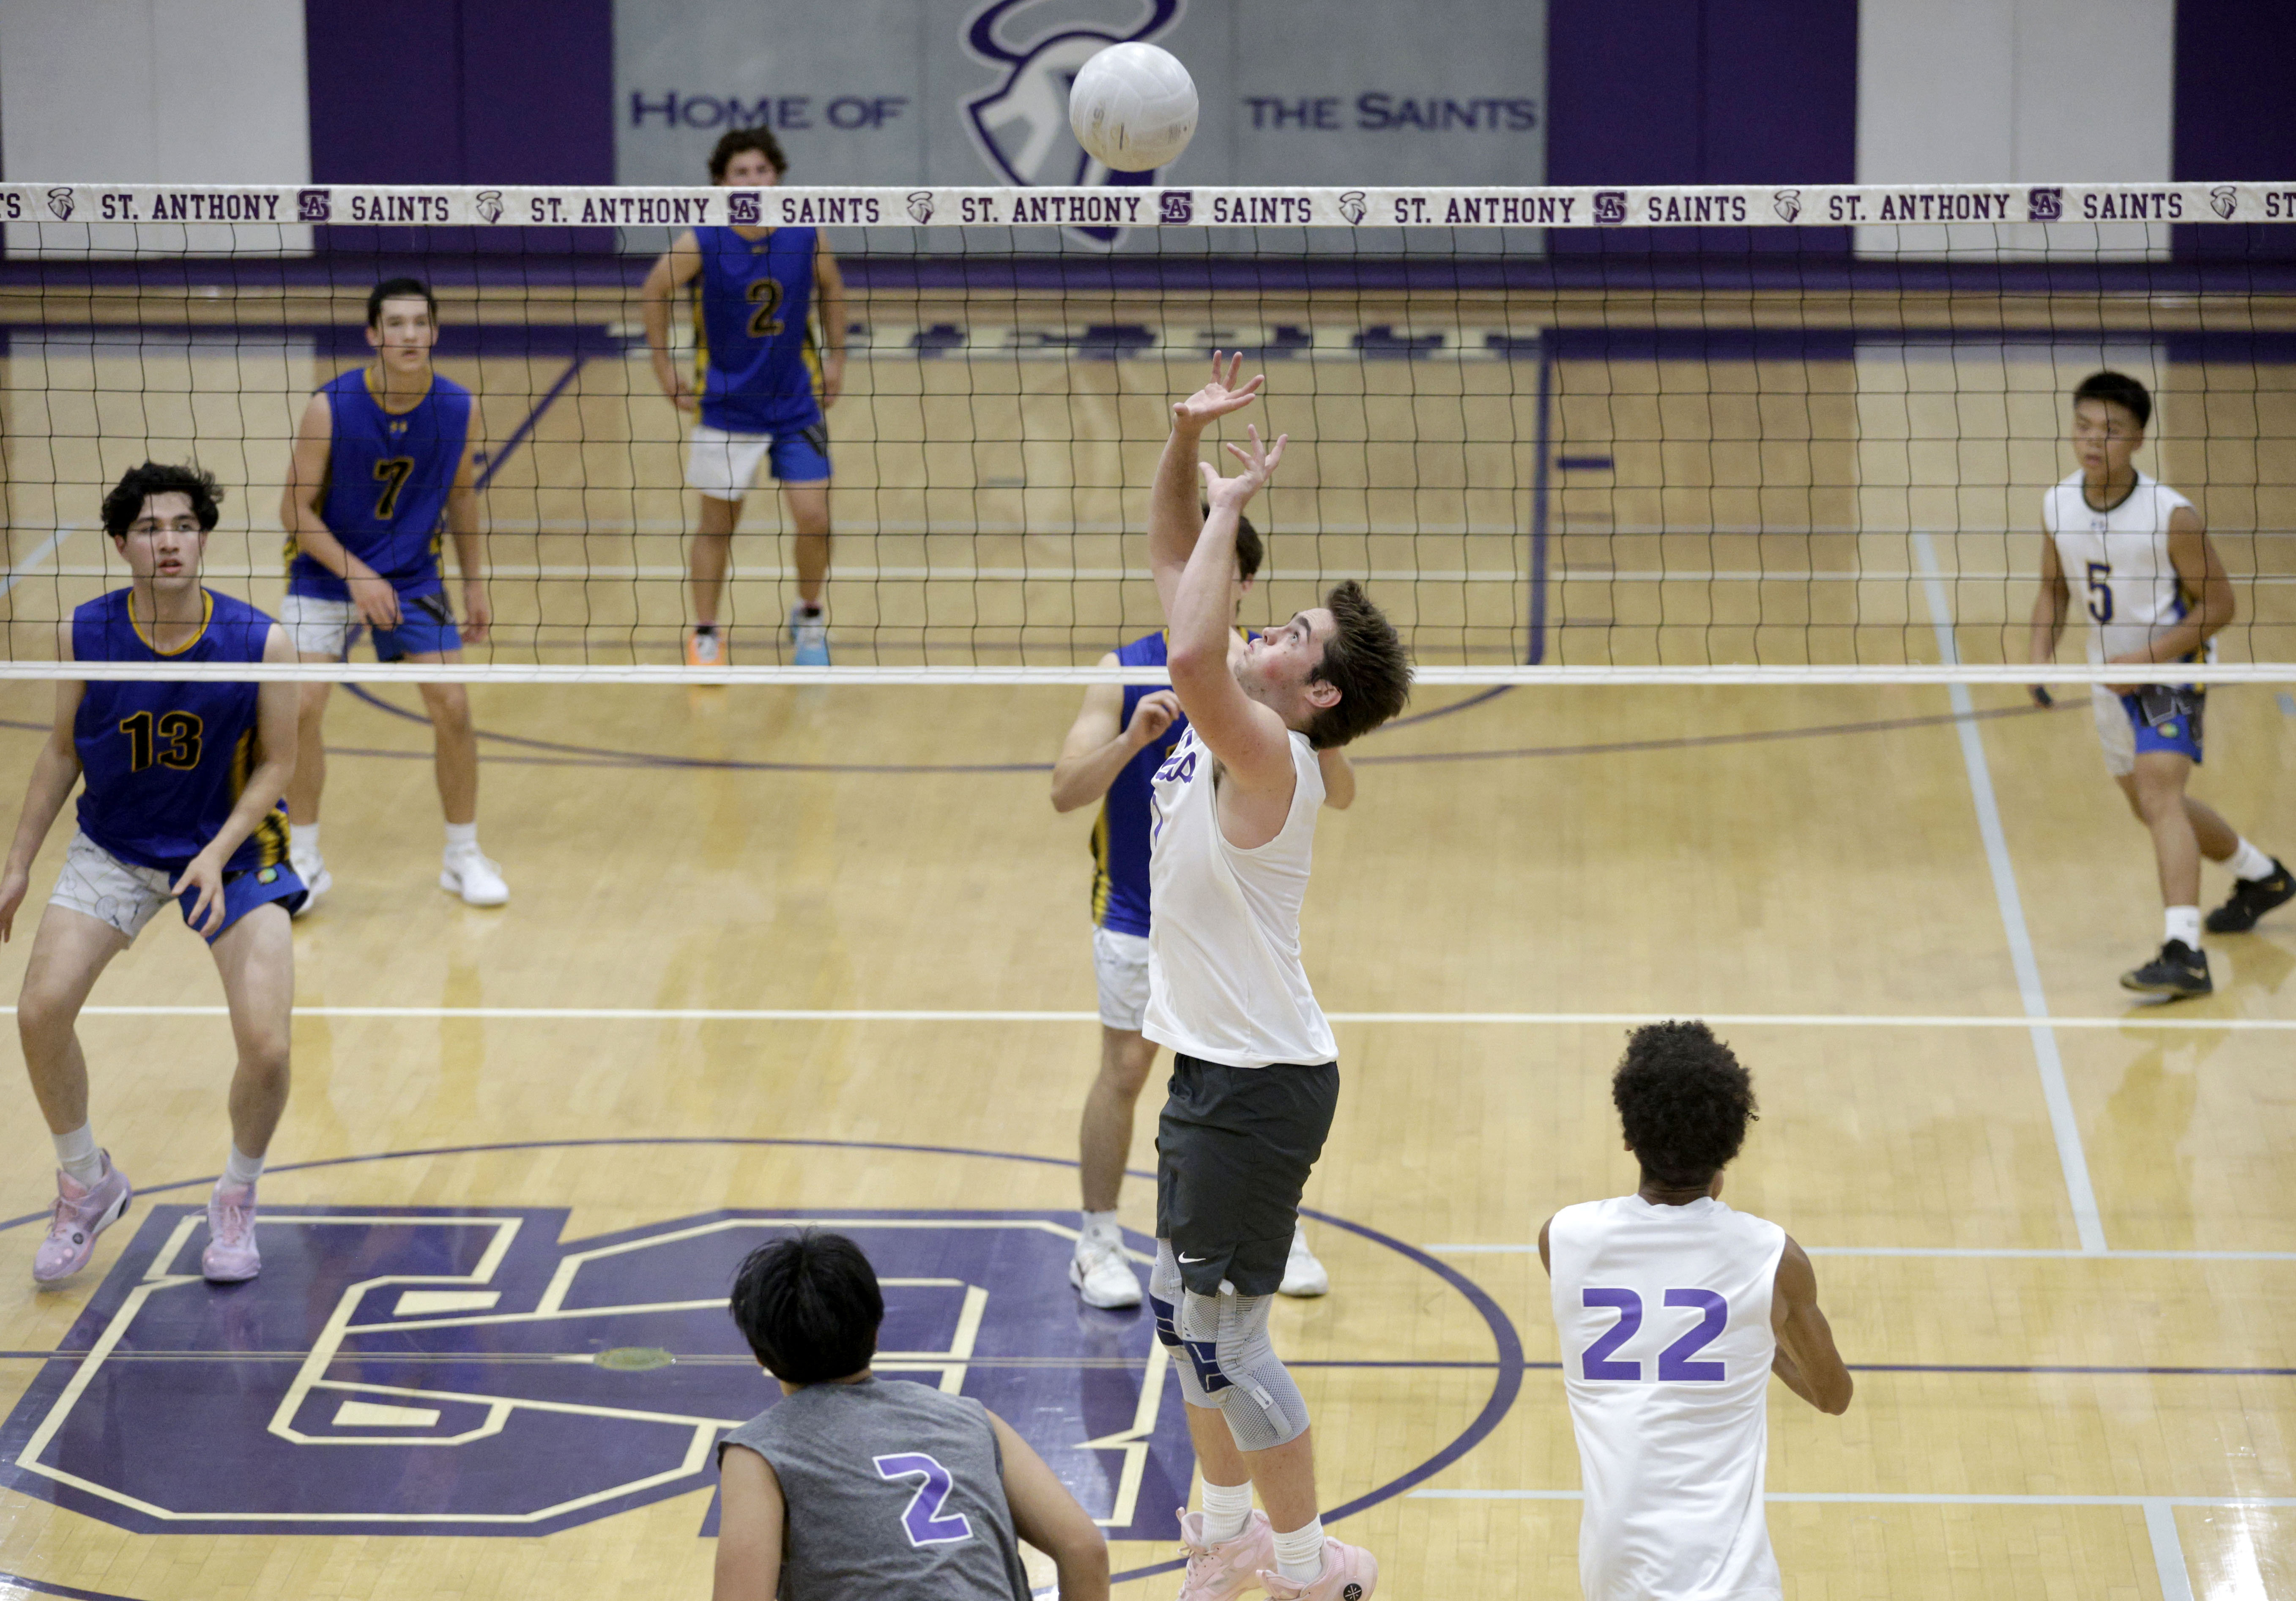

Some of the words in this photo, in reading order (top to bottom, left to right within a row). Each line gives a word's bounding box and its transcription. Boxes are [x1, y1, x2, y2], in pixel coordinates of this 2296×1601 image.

[630, 90, 811, 129] HOME
[826, 96, 909, 129] OF
[1243, 96, 1340, 129] THE
[1356, 91, 1537, 129] SAINTS
[102, 194, 138, 220] ST.
[152, 194, 279, 220] ANTHONY
[352, 196, 449, 222] SAINTS
[531, 197, 567, 222] ST.
[582, 198, 709, 223] ANTHONY
[783, 198, 879, 223] SAINTS
[962, 197, 998, 222] ST.
[1013, 197, 1140, 222] ANTHONY
[1215, 197, 1311, 223] SAINTS
[1395, 198, 1431, 223] ST.
[1445, 197, 1575, 223] ANTHONY
[1649, 196, 1746, 222] SAINTS
[1830, 195, 1866, 221] ST.
[1880, 194, 2010, 220] ANTHONY
[2084, 193, 2182, 219] SAINTS
[746, 277, 785, 338] 2
[373, 456, 415, 521] 7
[2086, 561, 2114, 625] 5
[119, 710, 204, 773] 13
[1580, 1286, 1729, 1383] 22
[873, 1452, 974, 1547] 2
